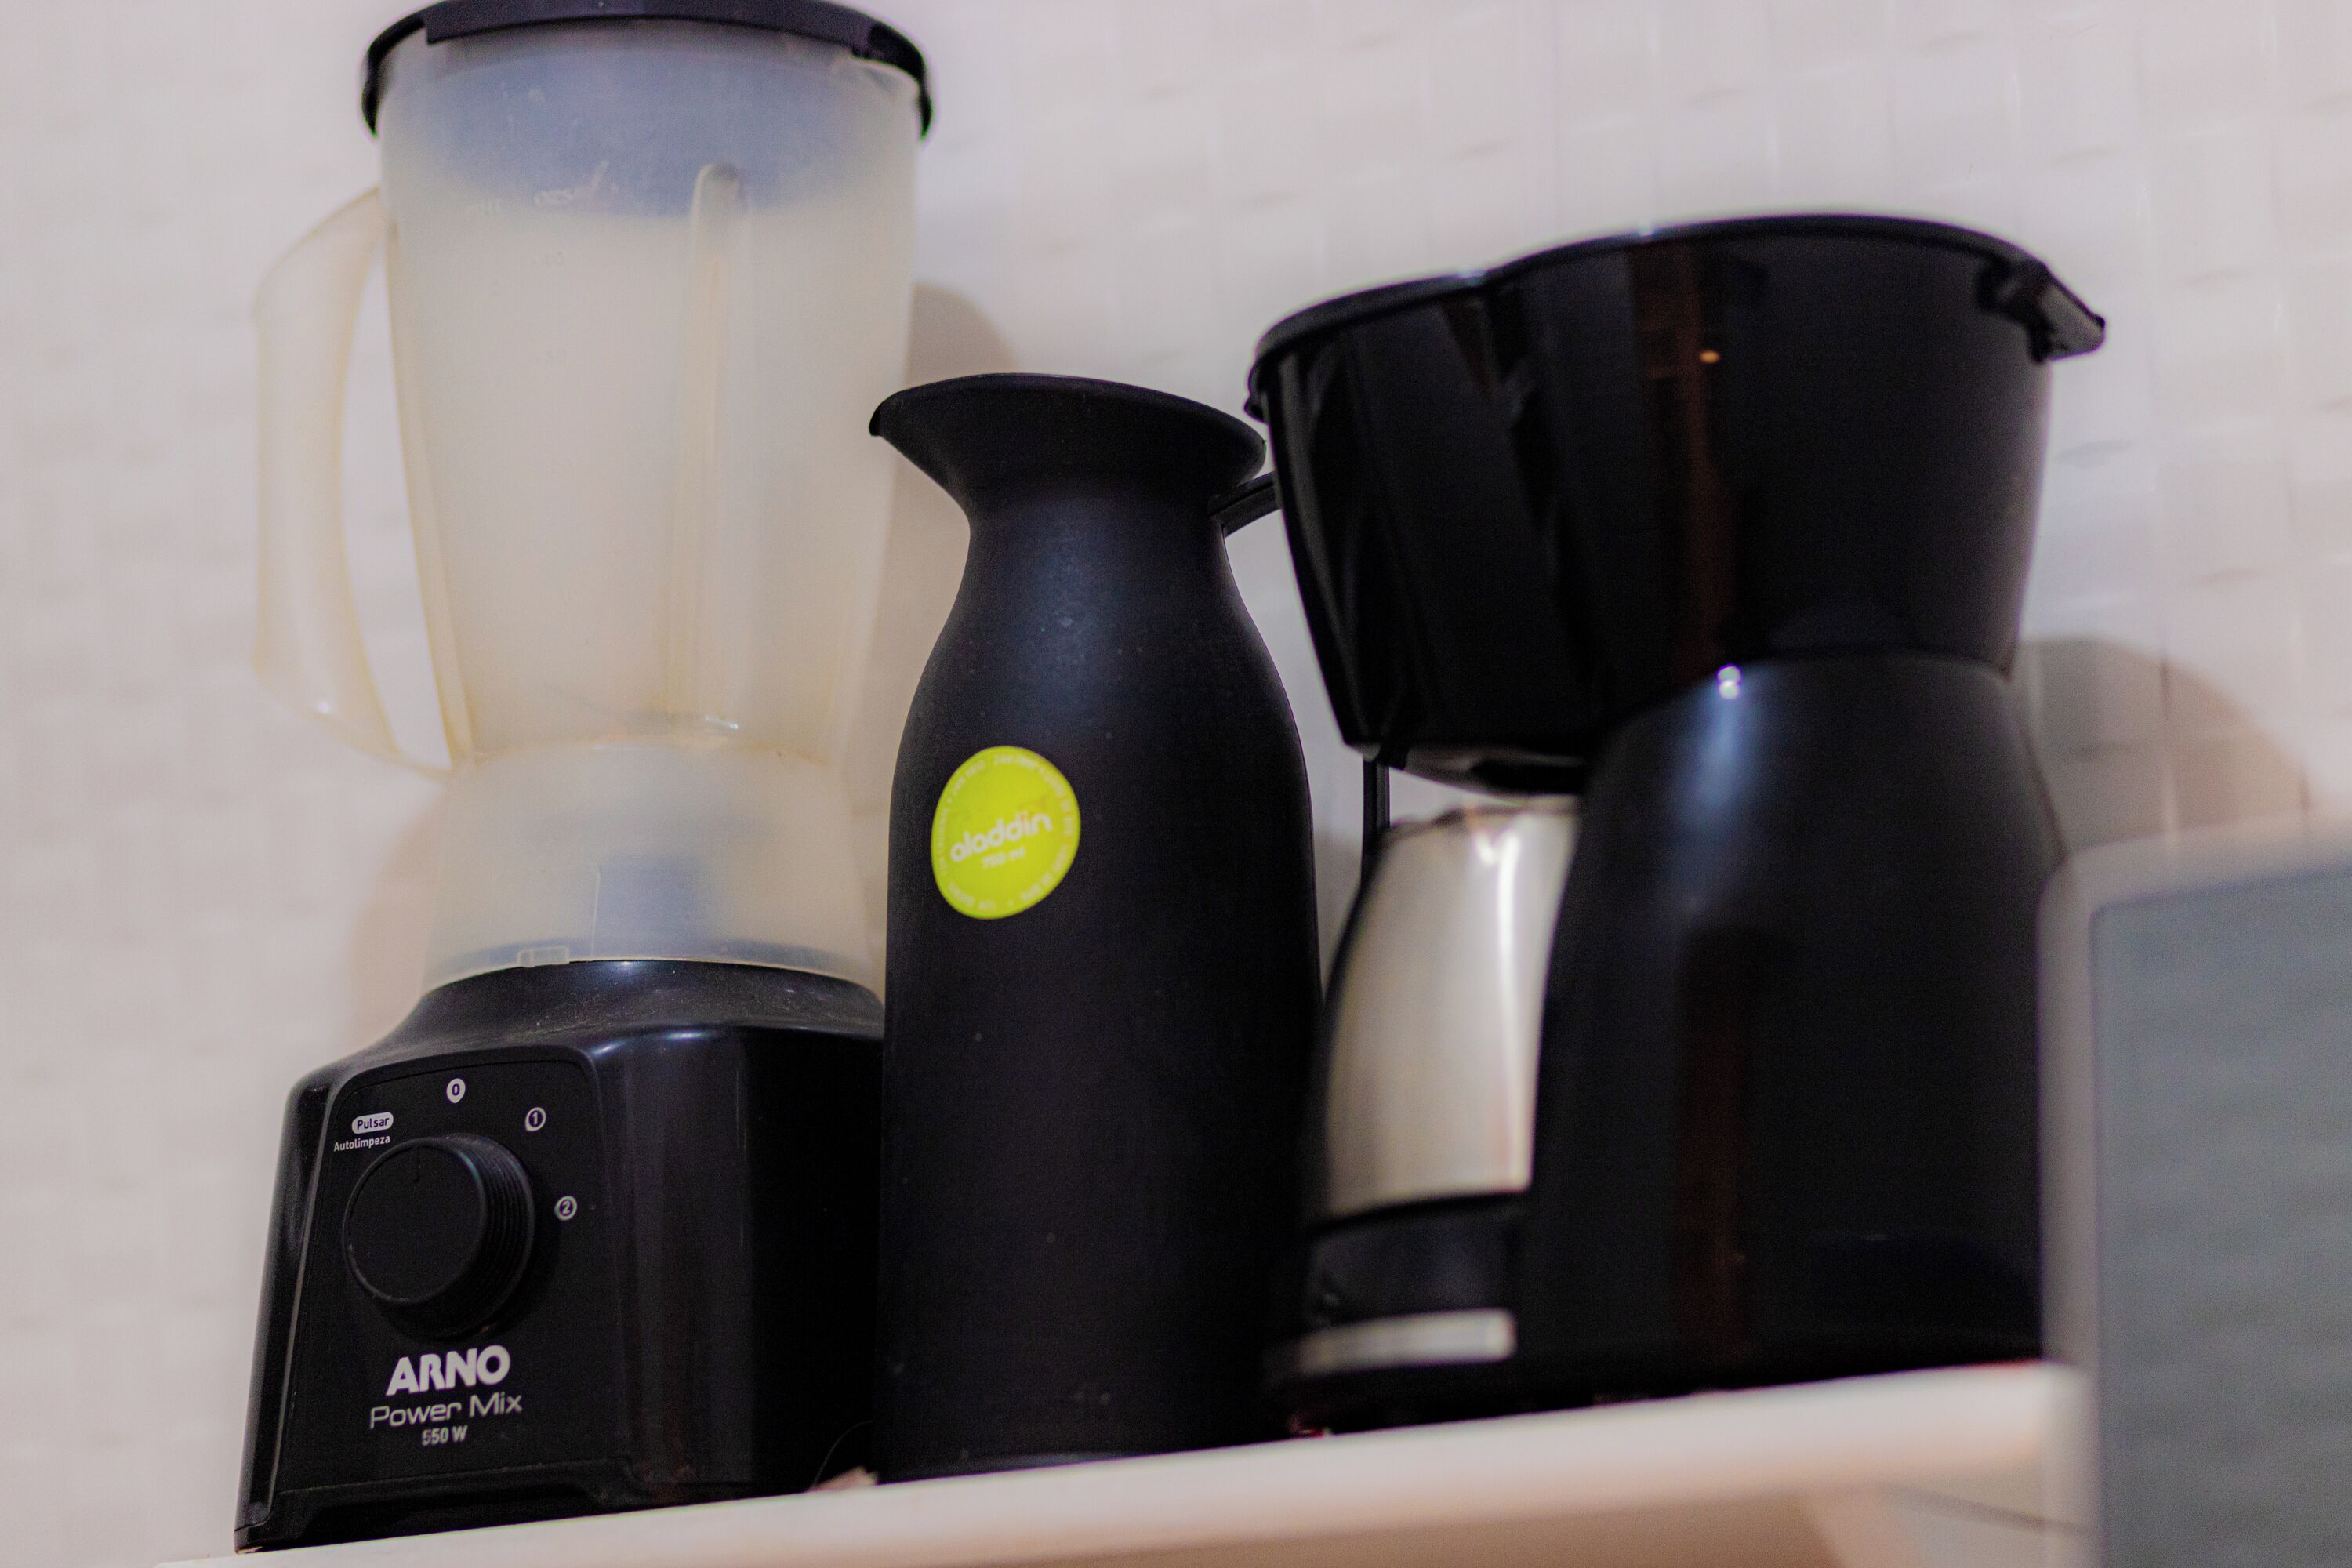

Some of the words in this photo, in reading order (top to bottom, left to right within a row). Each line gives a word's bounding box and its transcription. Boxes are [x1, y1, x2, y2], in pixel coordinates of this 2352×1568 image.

[949, 810, 1053, 862] aladdin
[356, 1117, 390, 1131] Pulsar
[333, 1135, 390, 1152] Autolimpeza
[386, 1345, 510, 1396] ARNO
[370, 1401, 463, 1429] Power
[469, 1392, 523, 1418] Mix
[421, 1427, 449, 1446] 550
[451, 1425, 468, 1443] W
